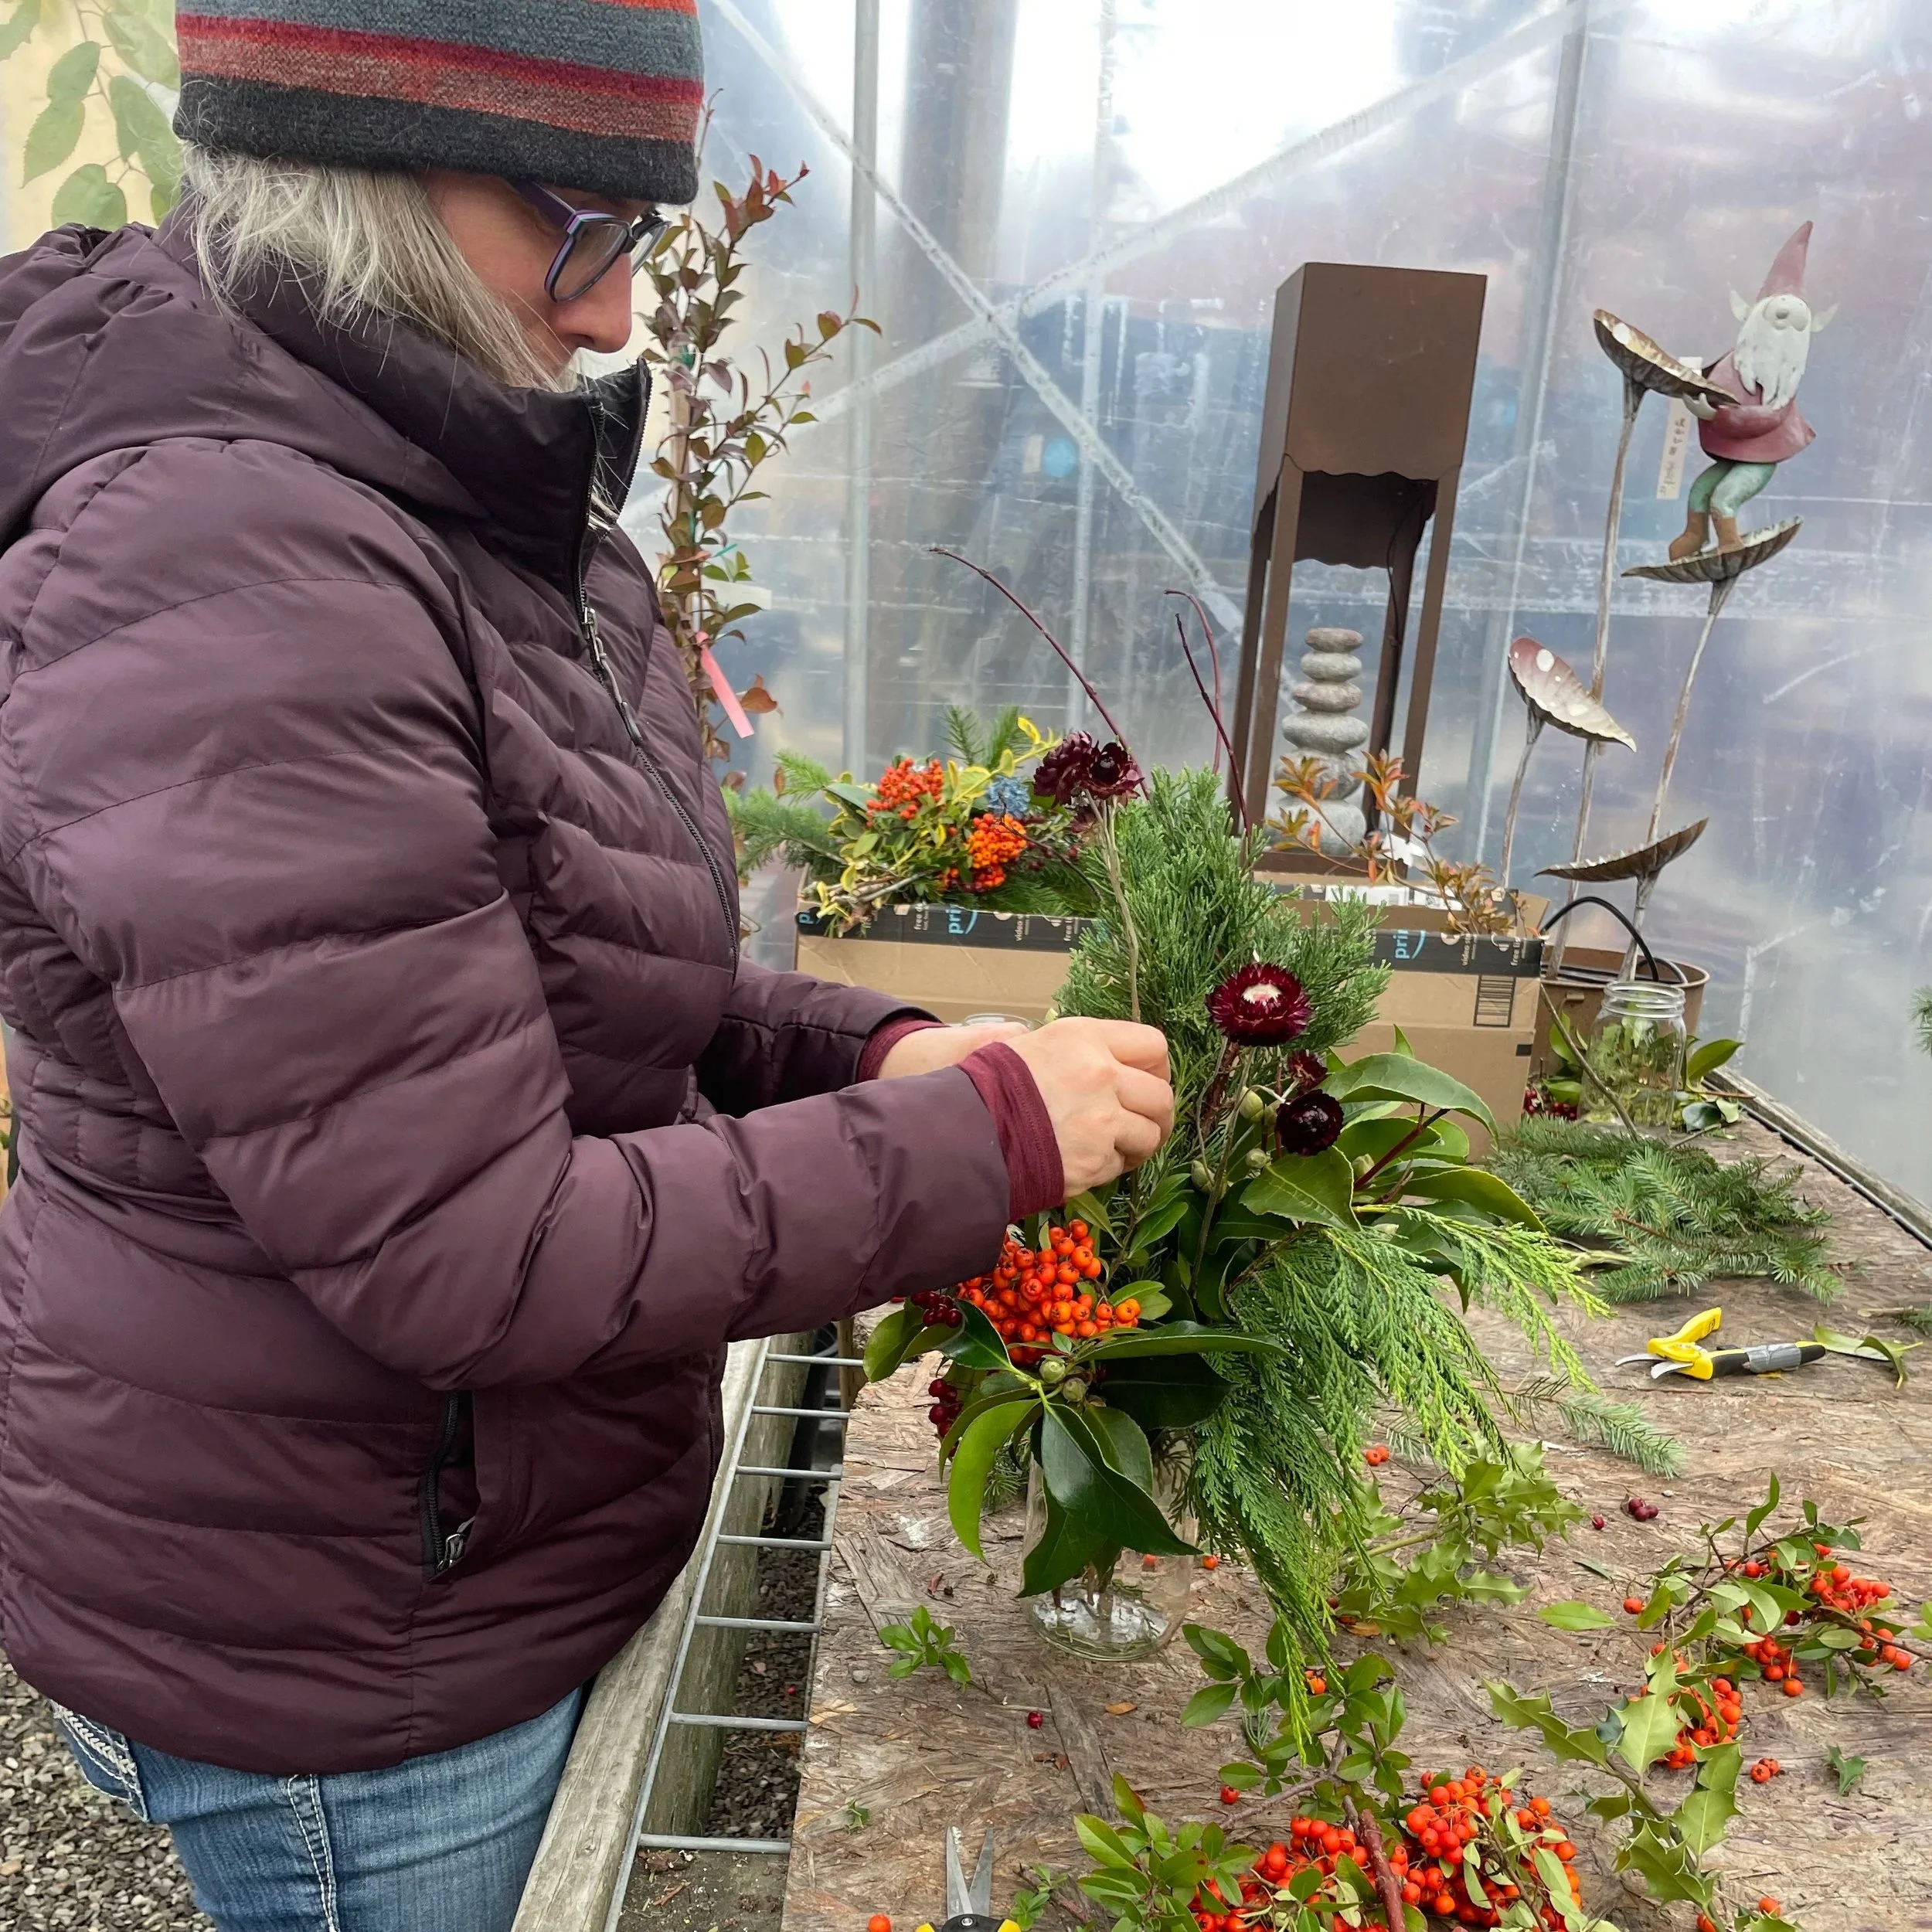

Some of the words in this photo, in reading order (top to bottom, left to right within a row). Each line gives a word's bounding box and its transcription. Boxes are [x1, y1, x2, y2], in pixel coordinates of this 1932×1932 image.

[913, 914, 923, 930] free
[945, 903, 964, 934] pri
[1015, 920, 1023, 941] video
[1063, 925, 1073, 941] free
[1461, 945, 1470, 966] video
[1510, 950, 1519, 966] free
